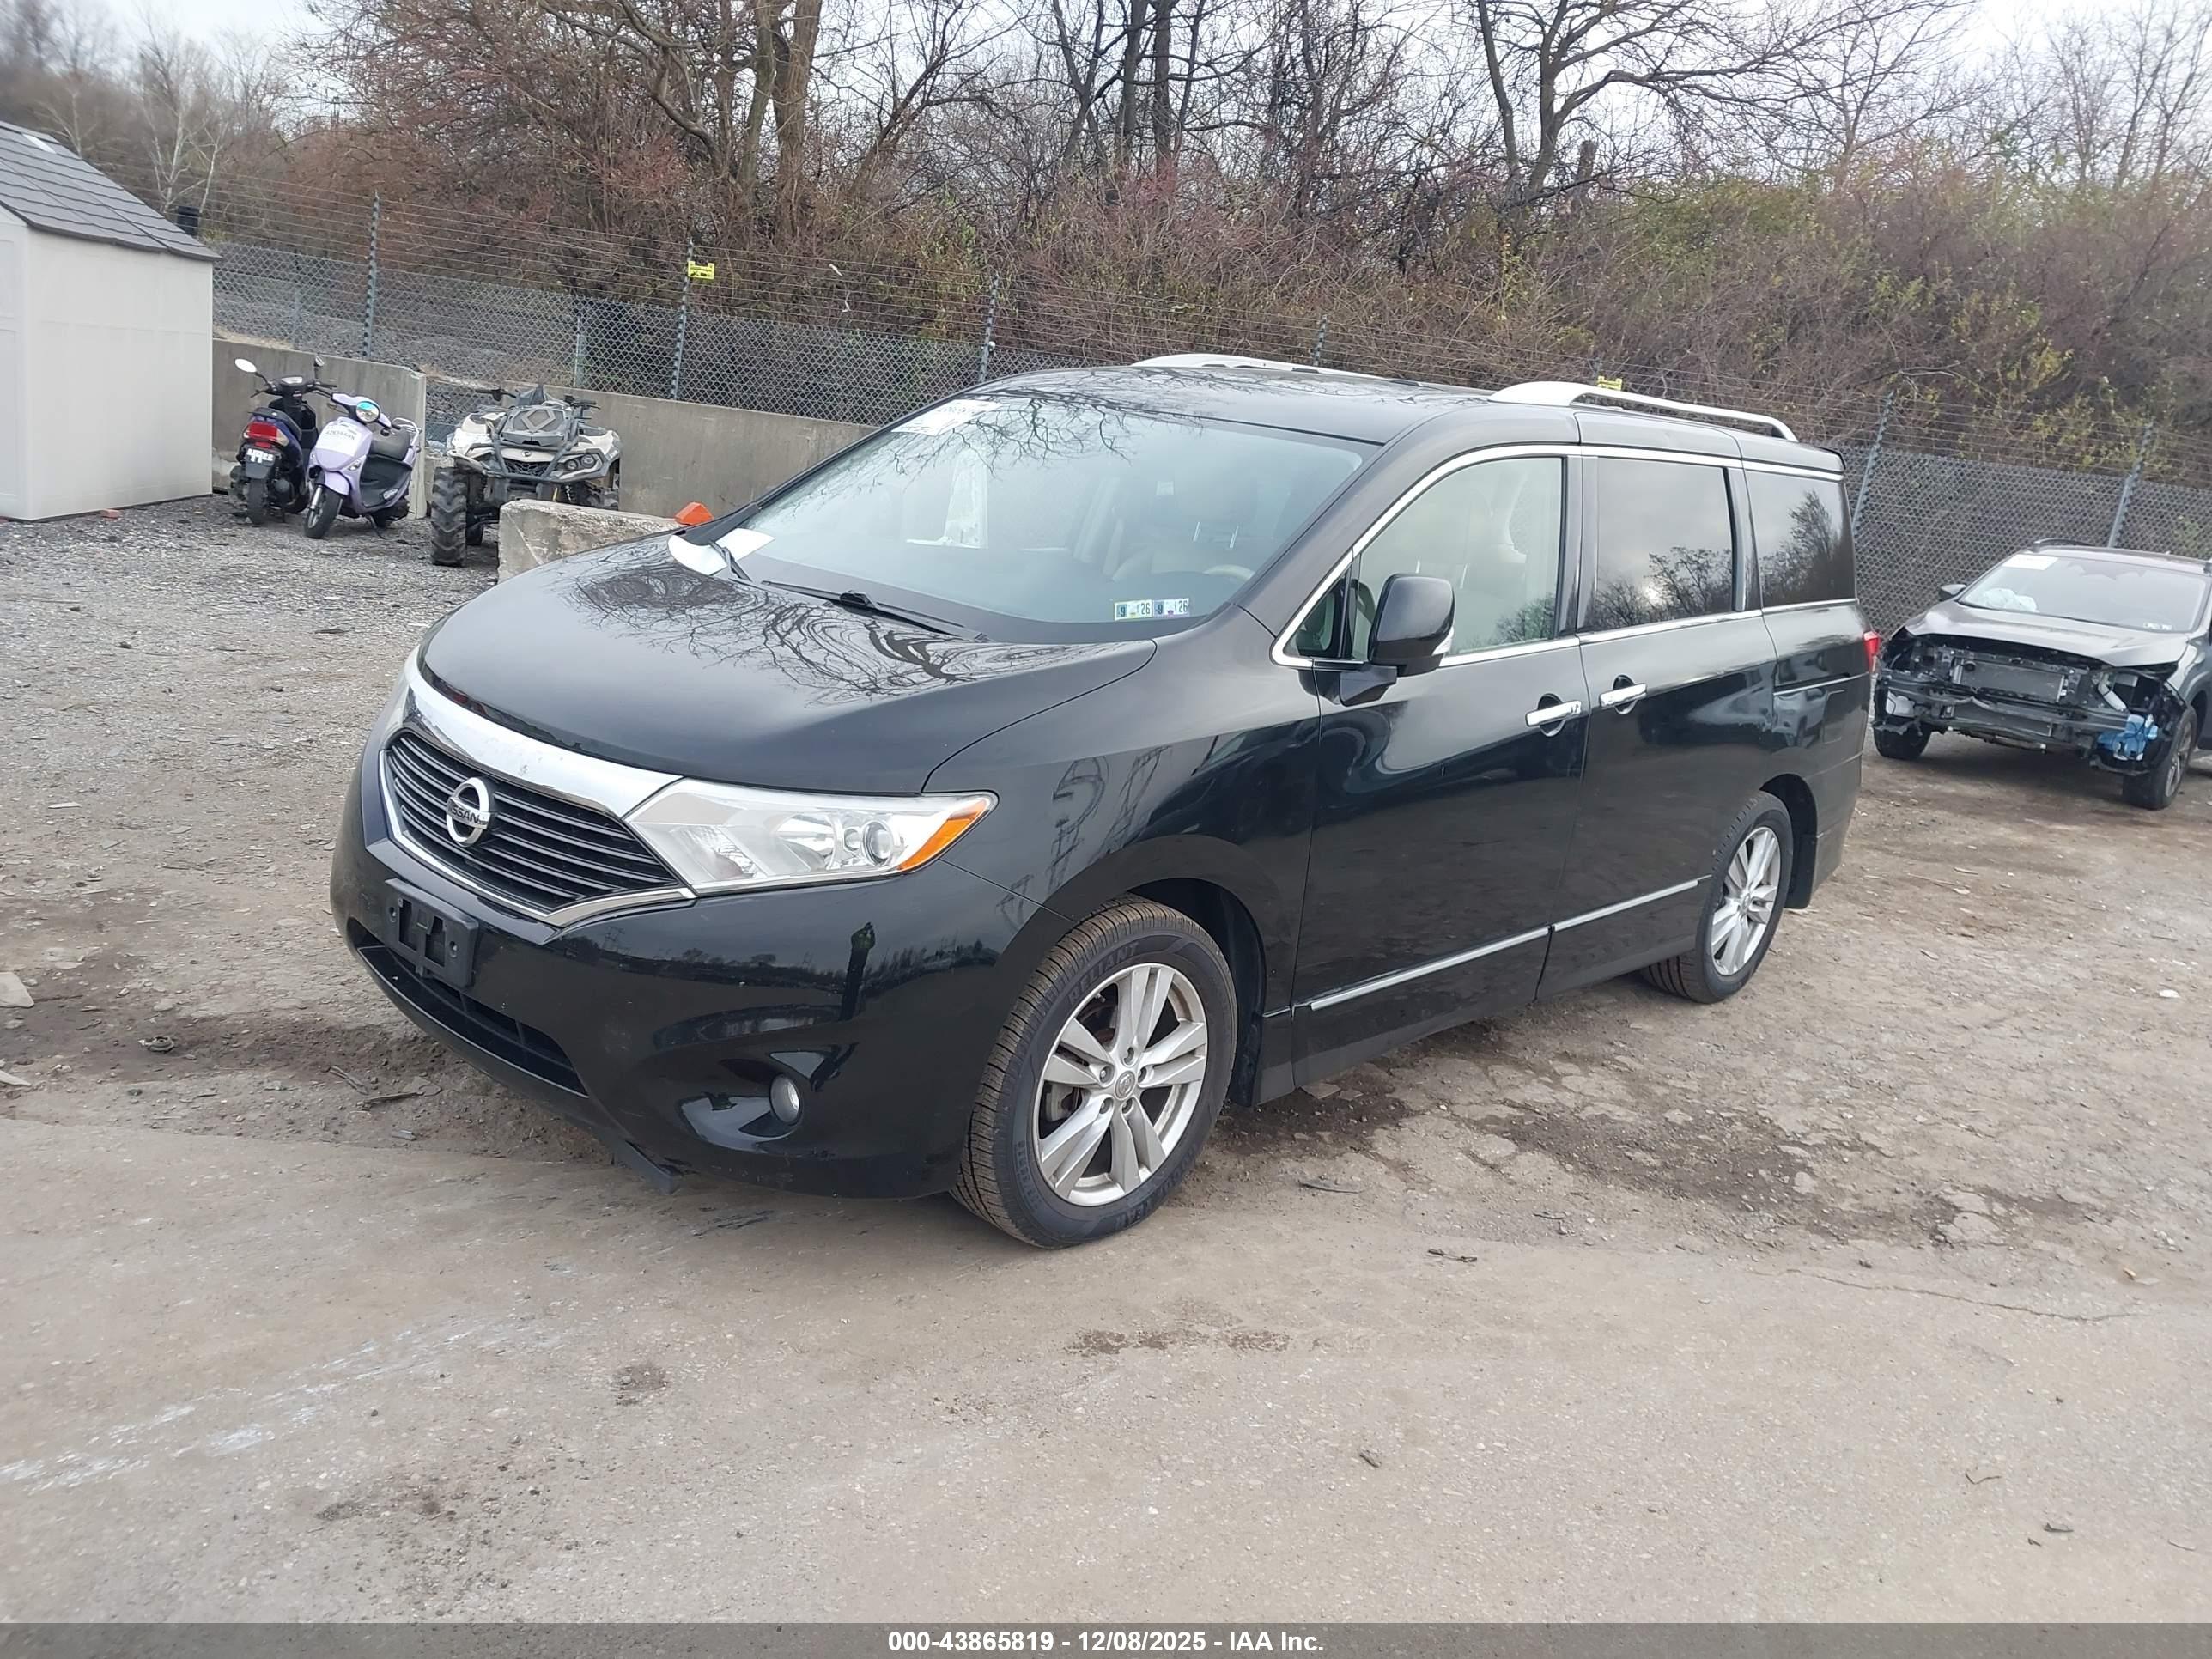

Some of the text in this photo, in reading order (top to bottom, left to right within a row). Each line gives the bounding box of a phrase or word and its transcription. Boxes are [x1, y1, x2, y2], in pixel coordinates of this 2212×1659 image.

[1140, 602, 1151, 615] 26
[1178, 600, 1188, 613] 26
[447, 799, 481, 824] NISSAN
[1066, 942, 1139, 1006] RELIANT
